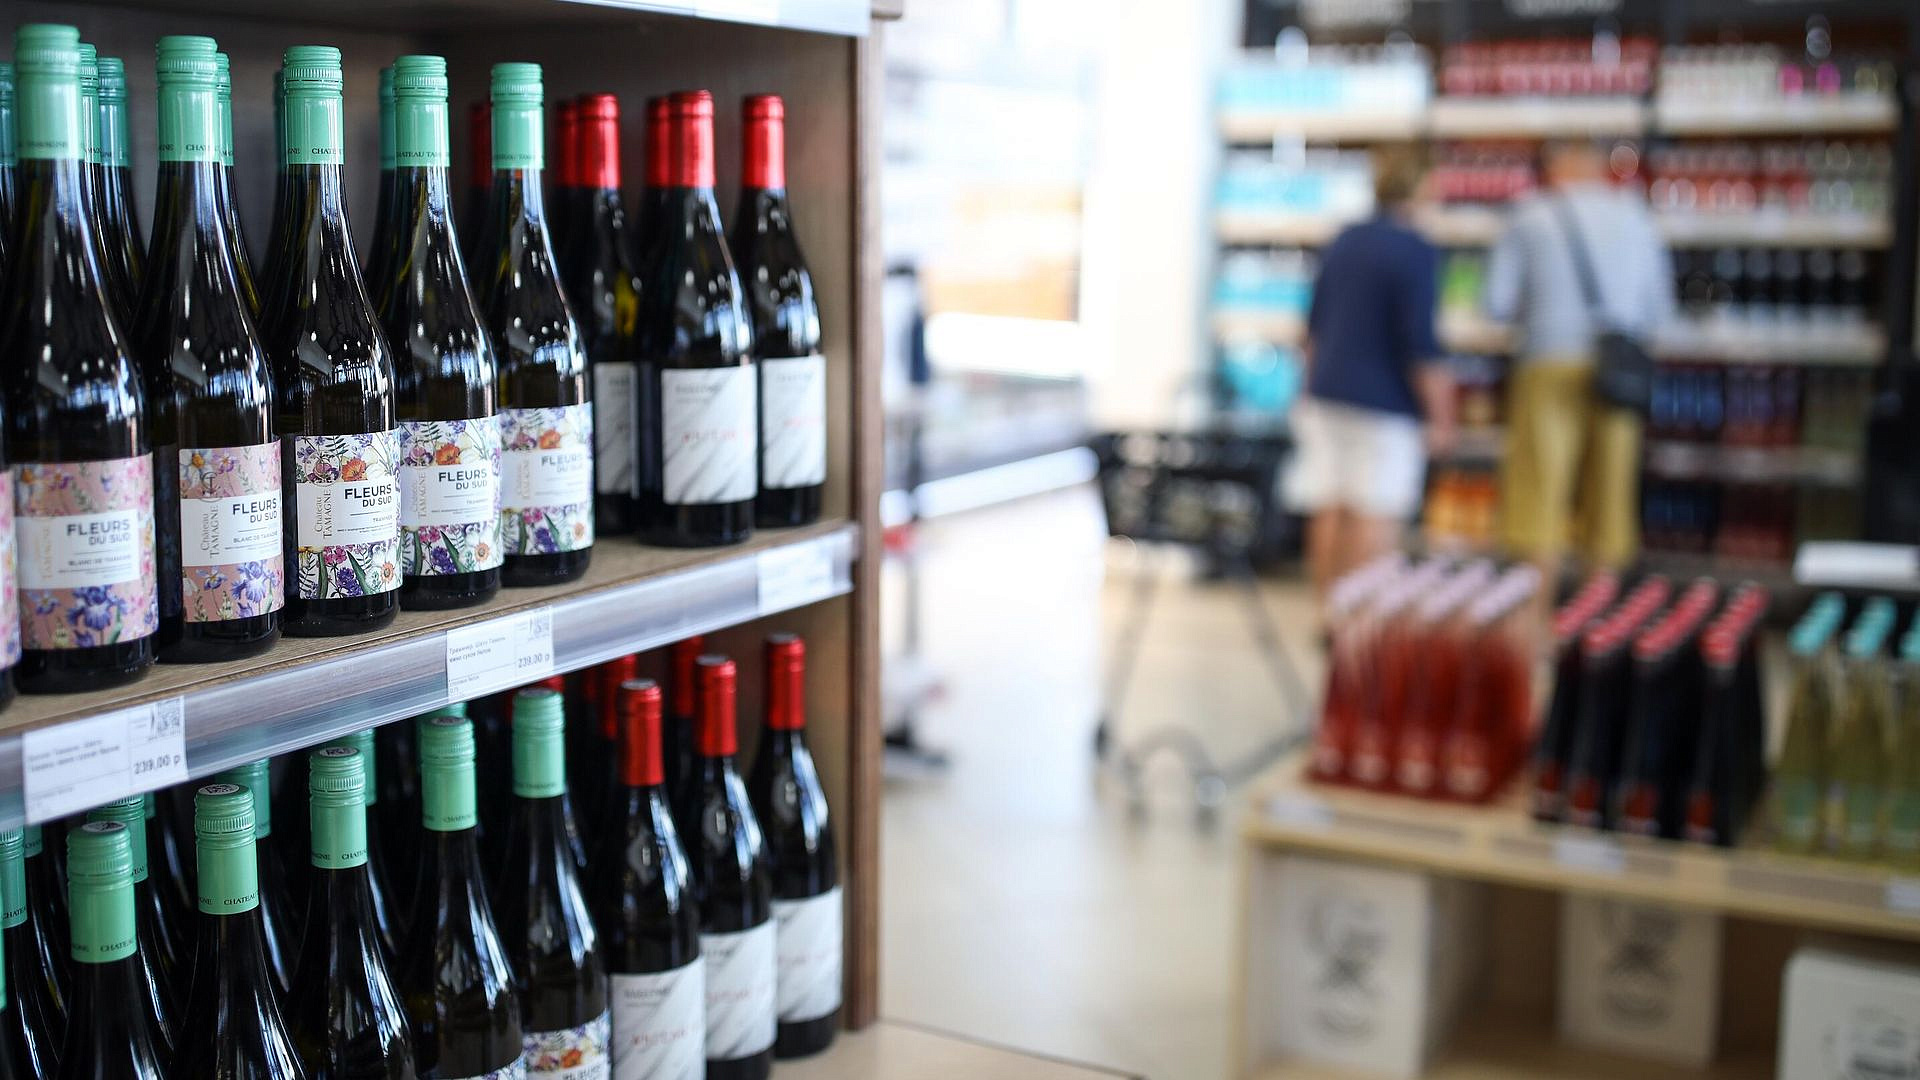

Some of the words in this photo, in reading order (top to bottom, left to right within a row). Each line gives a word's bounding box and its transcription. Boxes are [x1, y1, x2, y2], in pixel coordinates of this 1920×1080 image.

[438, 468, 488, 482] FLEURS
[344, 483, 392, 499] FLEURS
[455, 482, 469, 490] DU
[471, 480, 488, 489] SUD
[362, 499, 376, 508] DU
[377, 495, 392, 505] SUD
[418, 471, 427, 519] TAMAGNE
[232, 498, 277, 515] FLEURS
[323, 488, 332, 539] TAMAGNE
[249, 514, 262, 523] DU
[264, 510, 277, 521] SUD
[67, 519, 130, 536] FLEURS
[210, 505, 219, 559] TAMAGNE
[88, 536, 106, 546] DU
